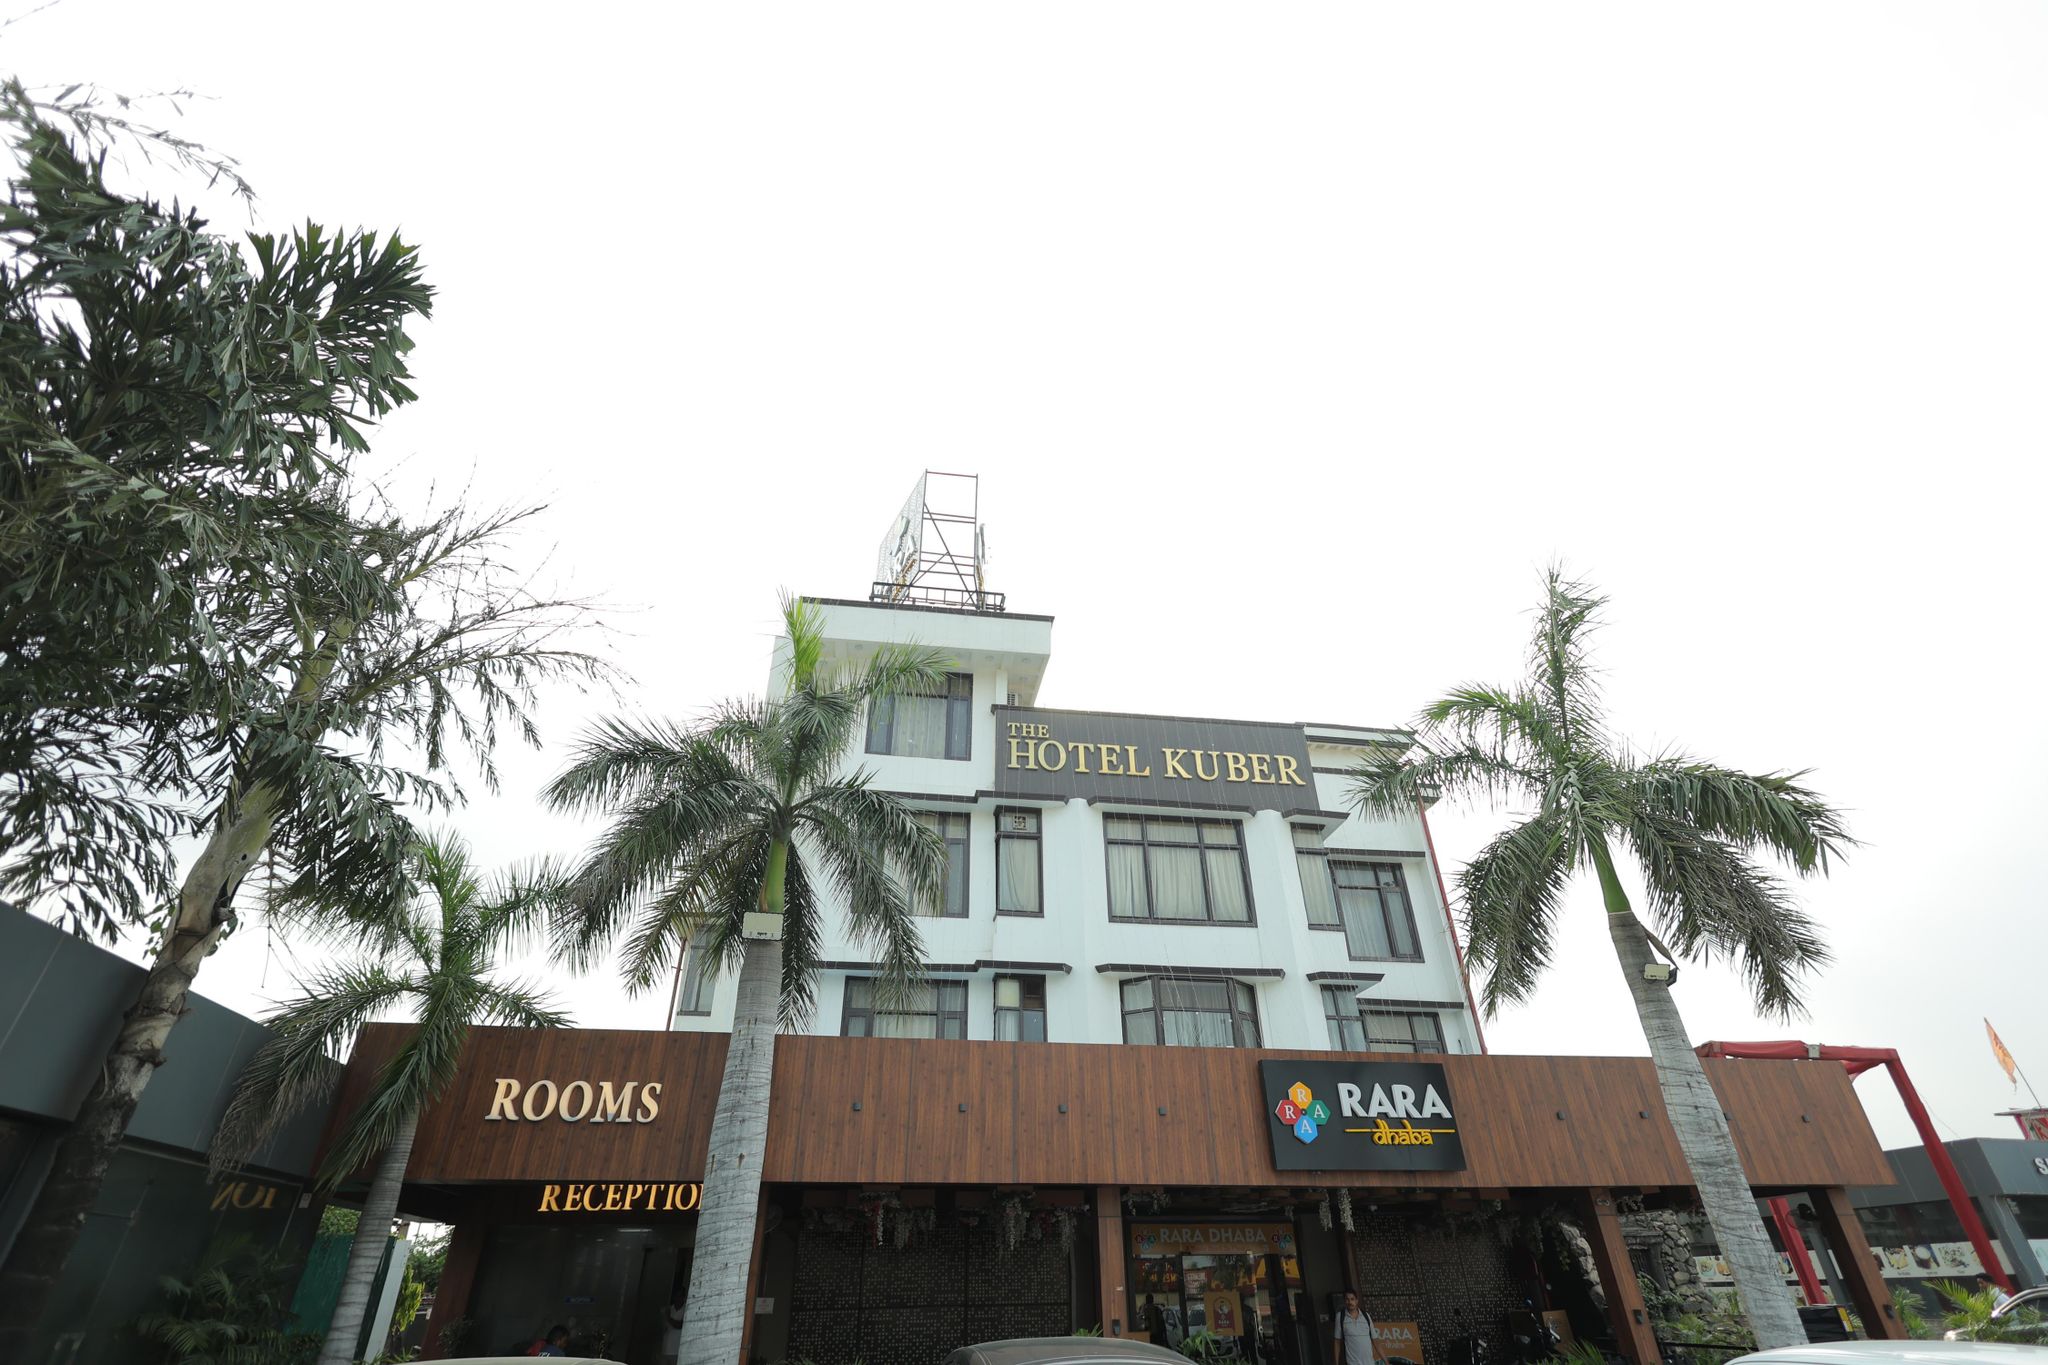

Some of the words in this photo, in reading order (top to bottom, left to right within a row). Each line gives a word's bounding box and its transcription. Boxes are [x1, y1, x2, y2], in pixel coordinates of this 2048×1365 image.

[1007, 722, 1049, 738] THE
[1007, 738, 1150, 778] HOTEL
[1161, 747, 1307, 786] KUBER
[484, 1078, 662, 1124] ROOMS
[1297, 1088, 1308, 1102] R
[1336, 1082, 1453, 1119] RARA
[1284, 1106, 1297, 1119] R
[1313, 1104, 1326, 1119] A
[1301, 1118, 1313, 1134] A
[1372, 1118, 1434, 1145] dhaba
[537, 1183, 704, 1212] RECEPTIO
[1159, 1228, 1202, 1243] RARA
[1208, 1227, 1267, 1243] DHABA
[1372, 1327, 1413, 1340] RARA
